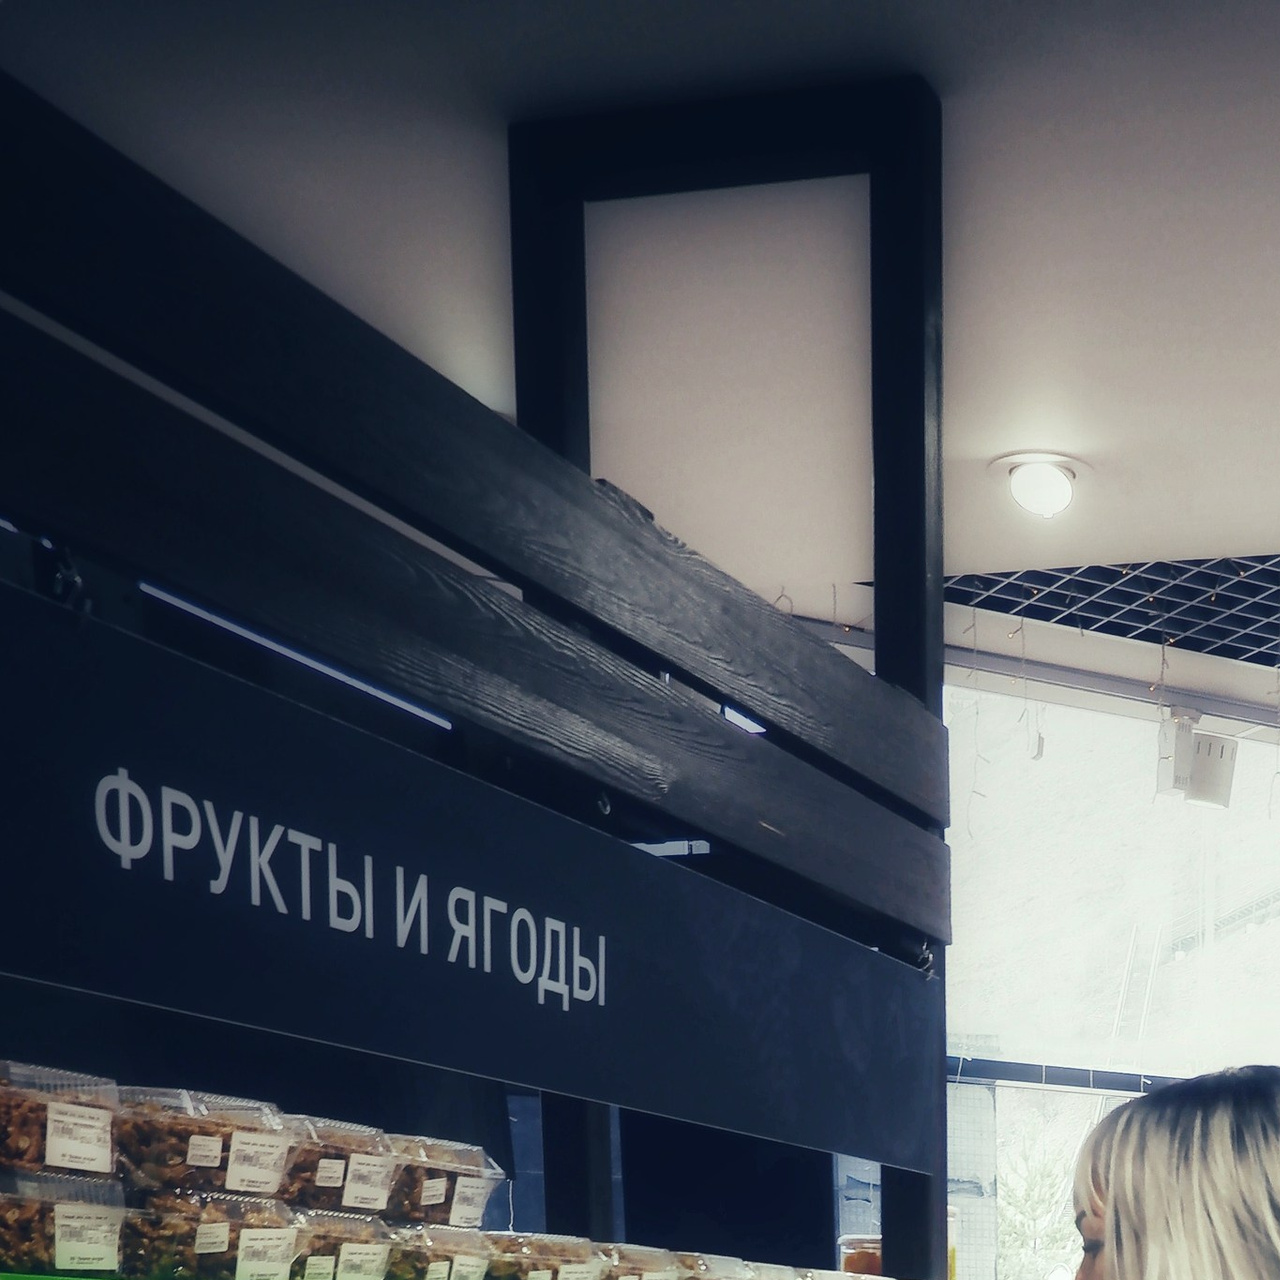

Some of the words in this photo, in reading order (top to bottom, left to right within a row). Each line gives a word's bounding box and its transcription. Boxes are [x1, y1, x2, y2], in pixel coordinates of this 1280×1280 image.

[95, 768, 374, 938] ФРУКТЫ
[396, 866, 428, 954] И
[447, 886, 606, 1011] ЯГОДЫ
